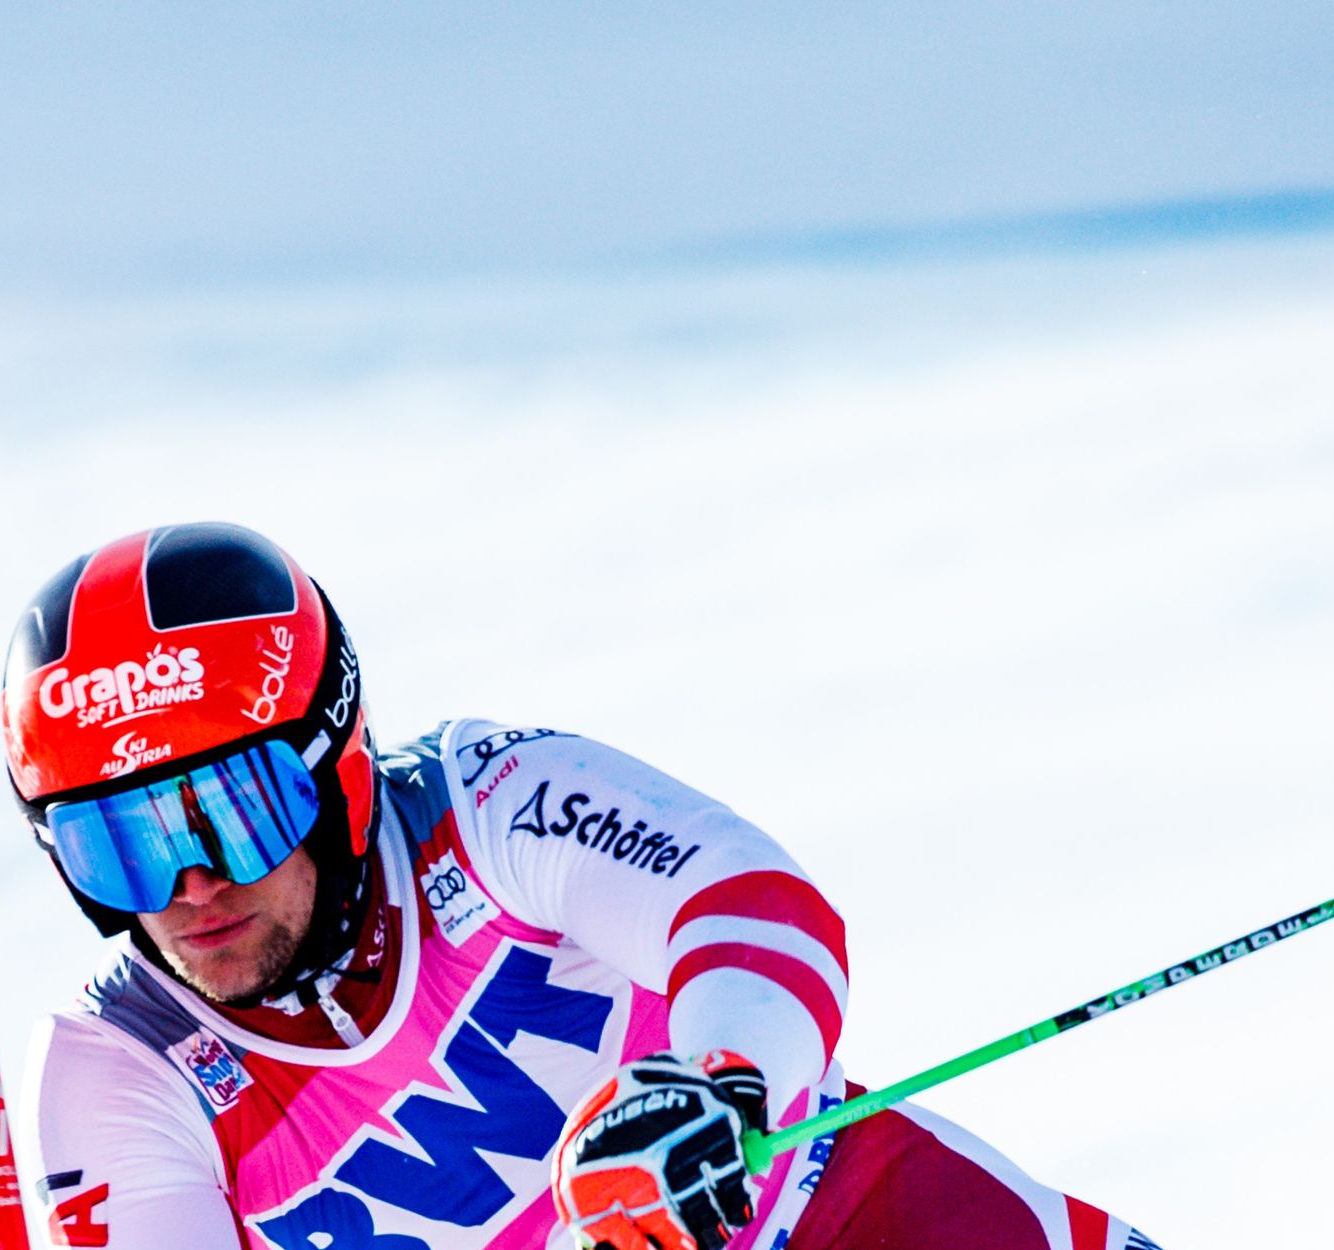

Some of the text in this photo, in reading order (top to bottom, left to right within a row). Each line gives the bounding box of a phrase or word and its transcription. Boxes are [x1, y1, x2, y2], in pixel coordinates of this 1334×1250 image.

[77, 682, 205, 728] SOFT DRINKS
[476, 756, 519, 808] Audi
[552, 793, 701, 878] Schöffel
